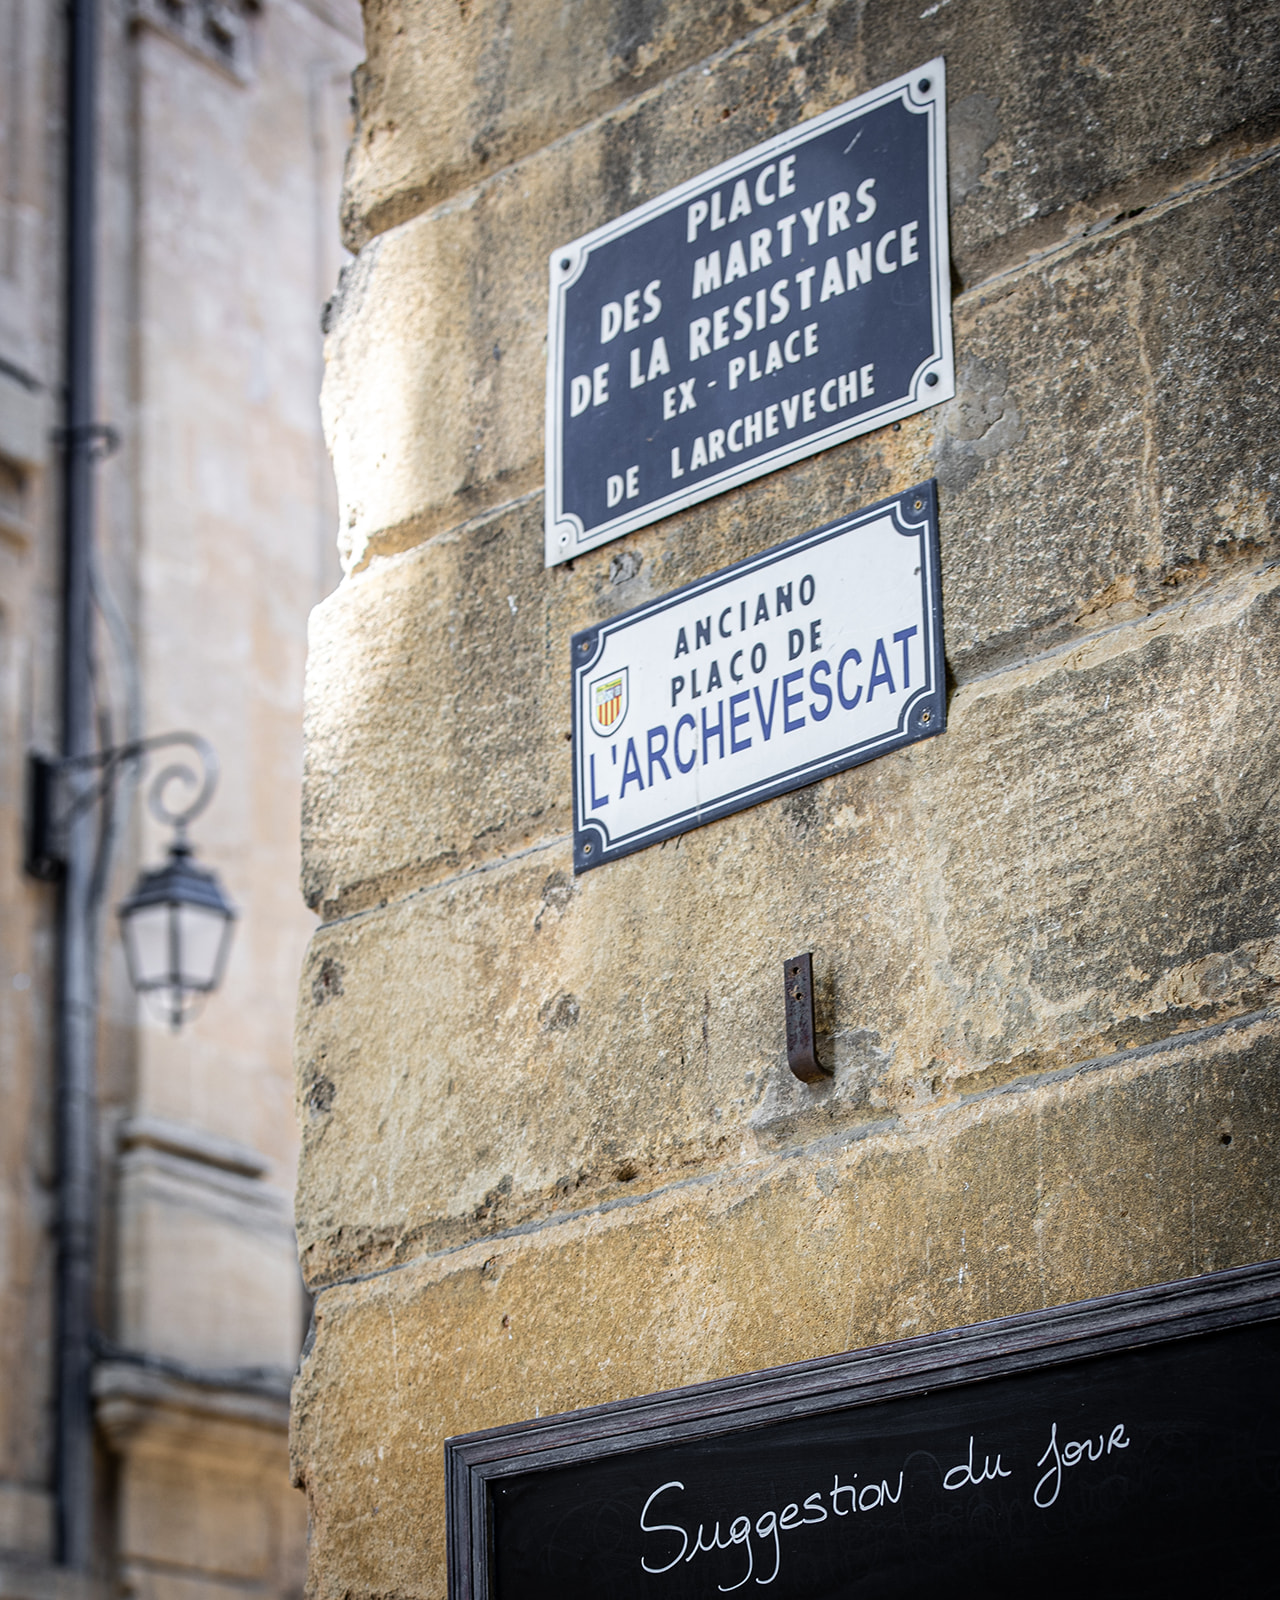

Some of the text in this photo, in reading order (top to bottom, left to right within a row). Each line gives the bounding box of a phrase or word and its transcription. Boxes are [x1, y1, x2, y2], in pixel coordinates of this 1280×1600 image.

[687, 154, 796, 243] PLACE
[600, 178, 877, 345] DES MARTYRS
[570, 220, 919, 418] DE LA RESISTANCE
[663, 377, 697, 421] EX
[728, 322, 819, 391] PLACE
[606, 465, 640, 508] DE
[674, 574, 816, 660] ANCIANO
[788, 618, 822, 661] DE
[590, 624, 918, 811] L'ARCHEVESCAT
[640, 1471, 904, 1592] Suggestion
[942, 1435, 1011, 1491] du
